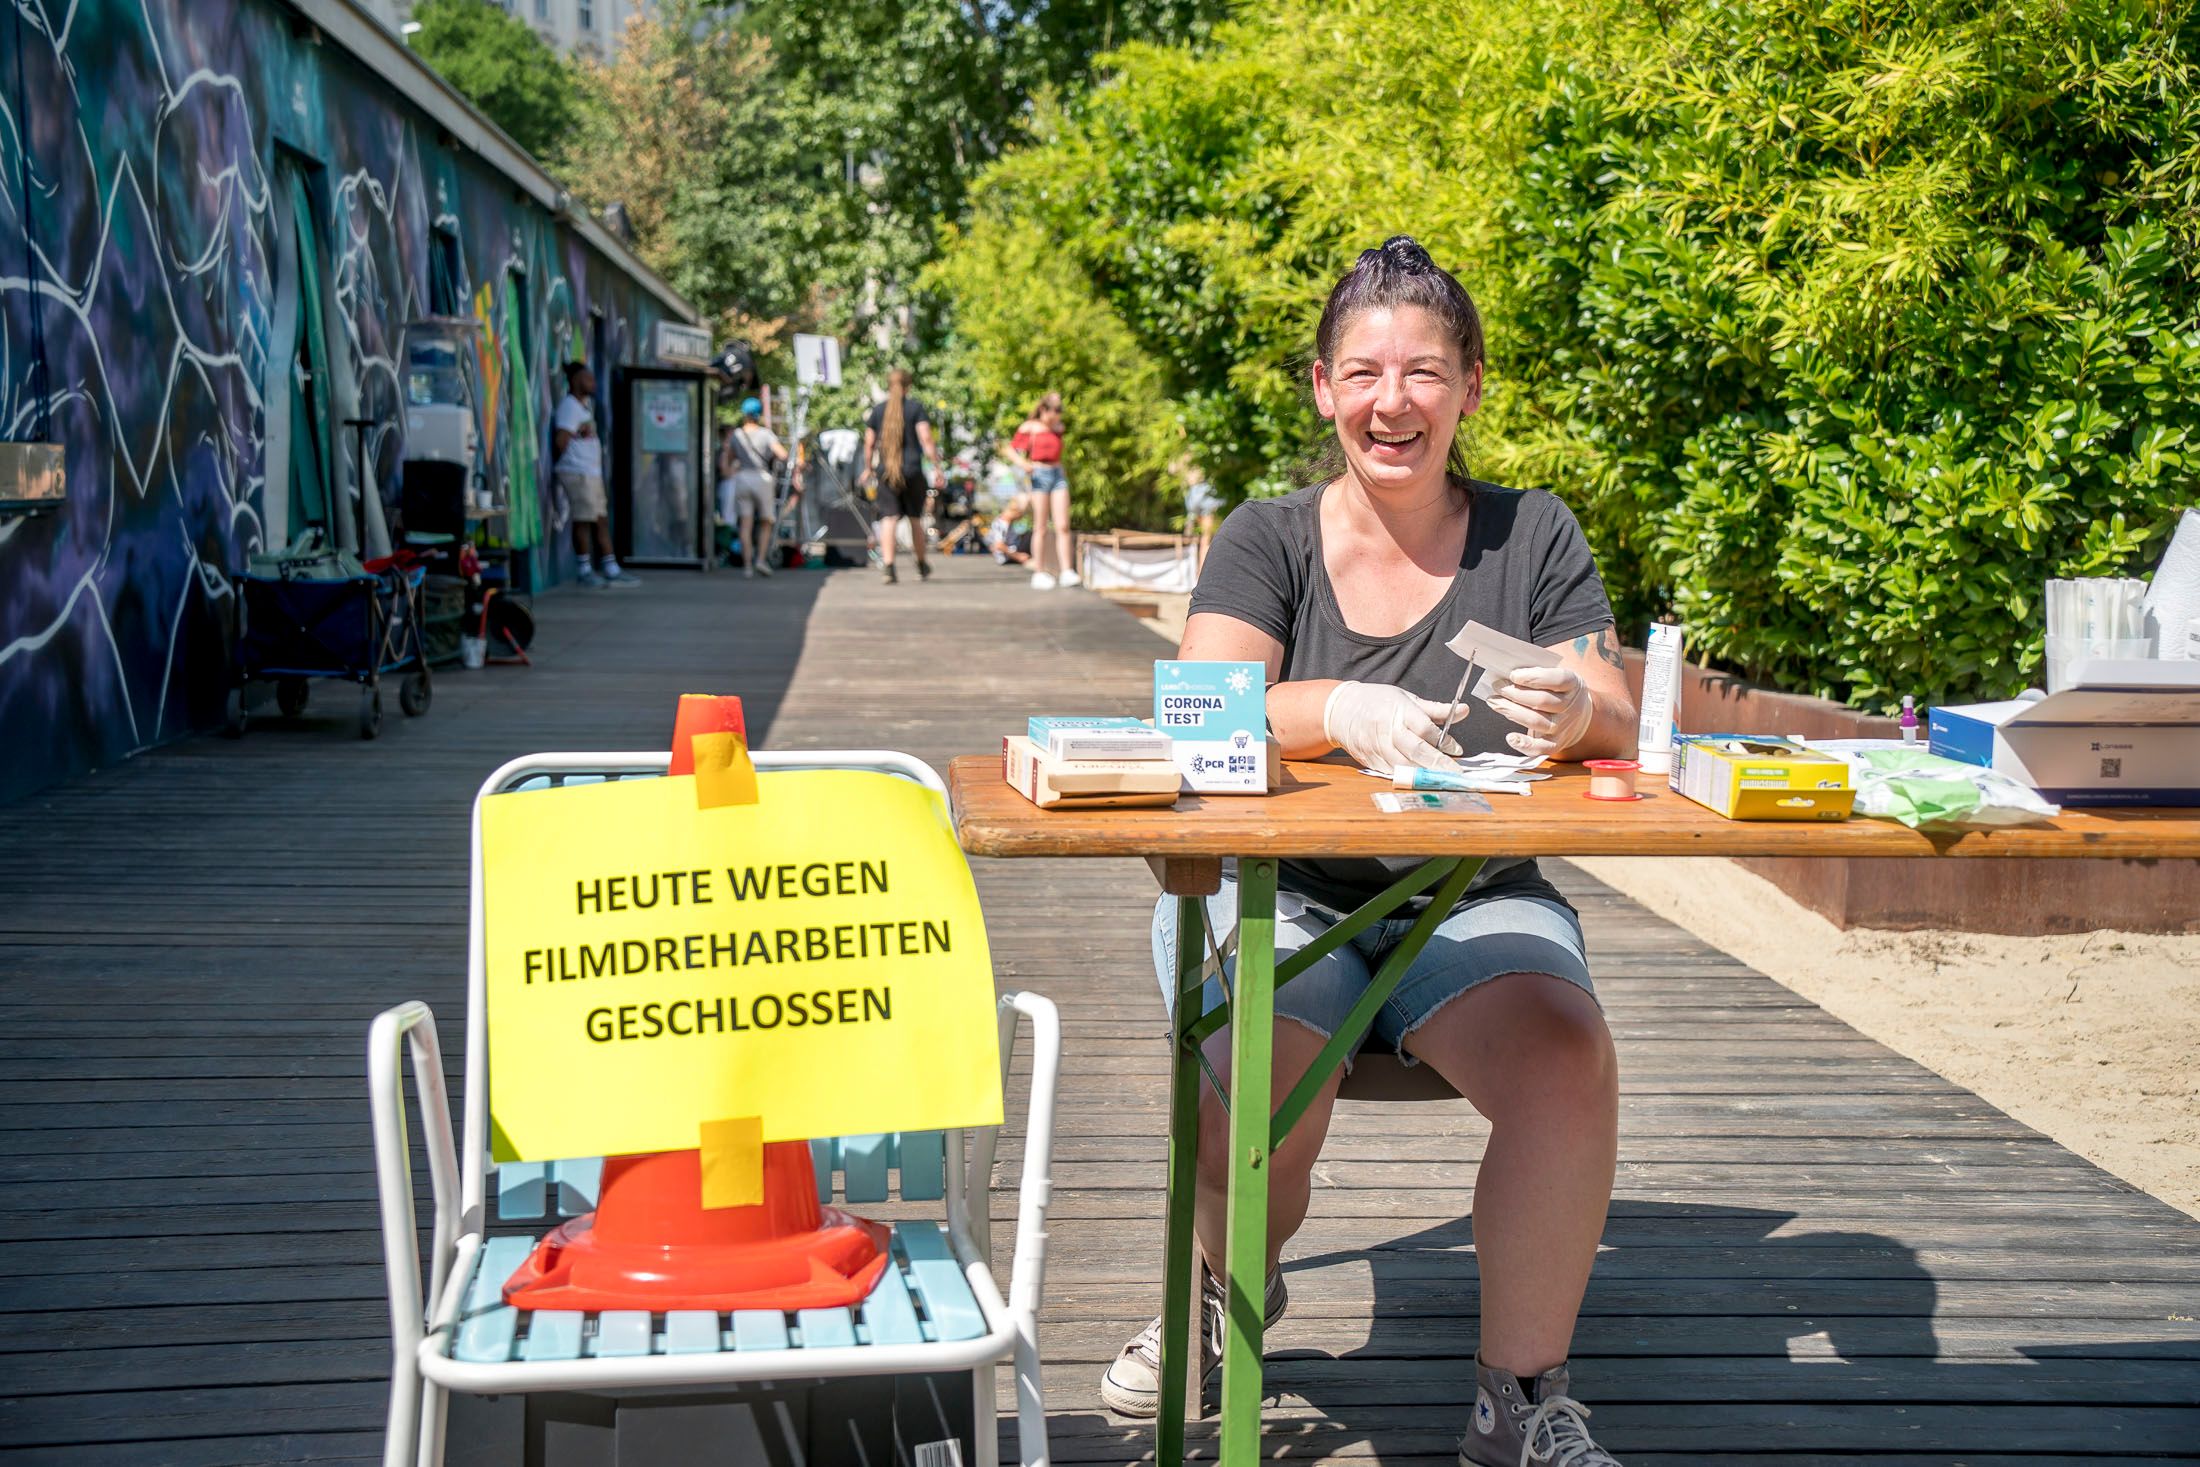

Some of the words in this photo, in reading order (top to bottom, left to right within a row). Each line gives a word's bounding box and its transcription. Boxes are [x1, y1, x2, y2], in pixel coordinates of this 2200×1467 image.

[1164, 697, 1223, 709] CORONA
[1164, 713, 1201, 725] TEST
[1205, 760, 1224, 769] PCR
[577, 869, 713, 915] HEUTE
[727, 860, 889, 901] WEGEN
[525, 920, 951, 985] FILMDREHARBEITEN
[586, 987, 891, 1042] GESCHLOSSEN
